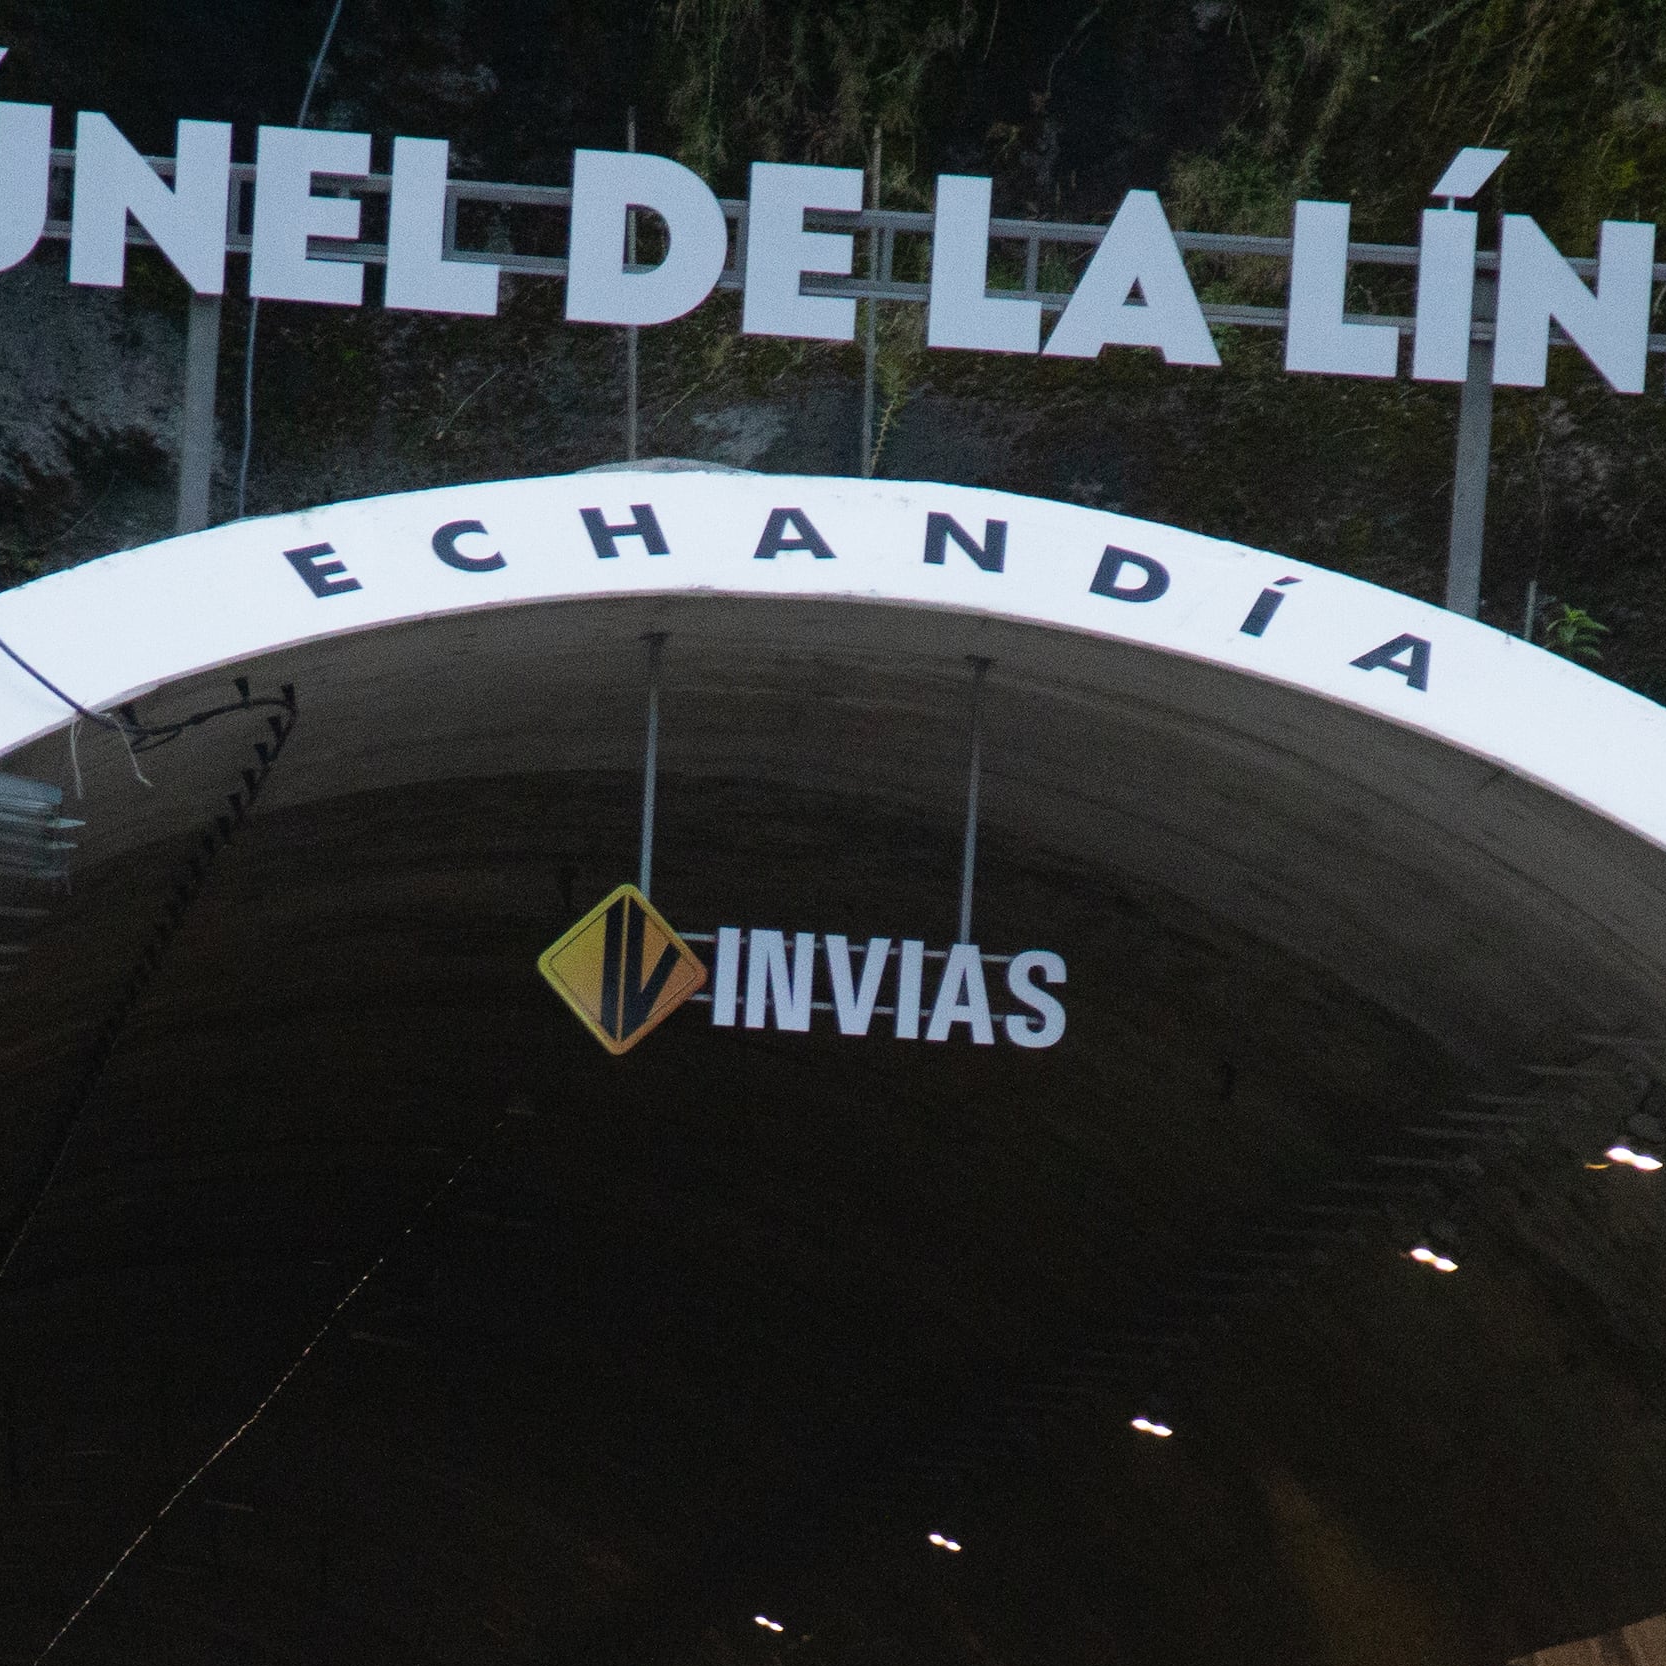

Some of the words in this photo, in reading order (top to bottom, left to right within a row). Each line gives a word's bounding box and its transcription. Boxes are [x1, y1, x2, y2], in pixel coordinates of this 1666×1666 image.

[566, 148, 865, 341] DE
[928, 174, 1221, 368] LA
[283, 503, 1433, 692] ECHANDÍA
[713, 926, 1068, 1049] INVIAS
